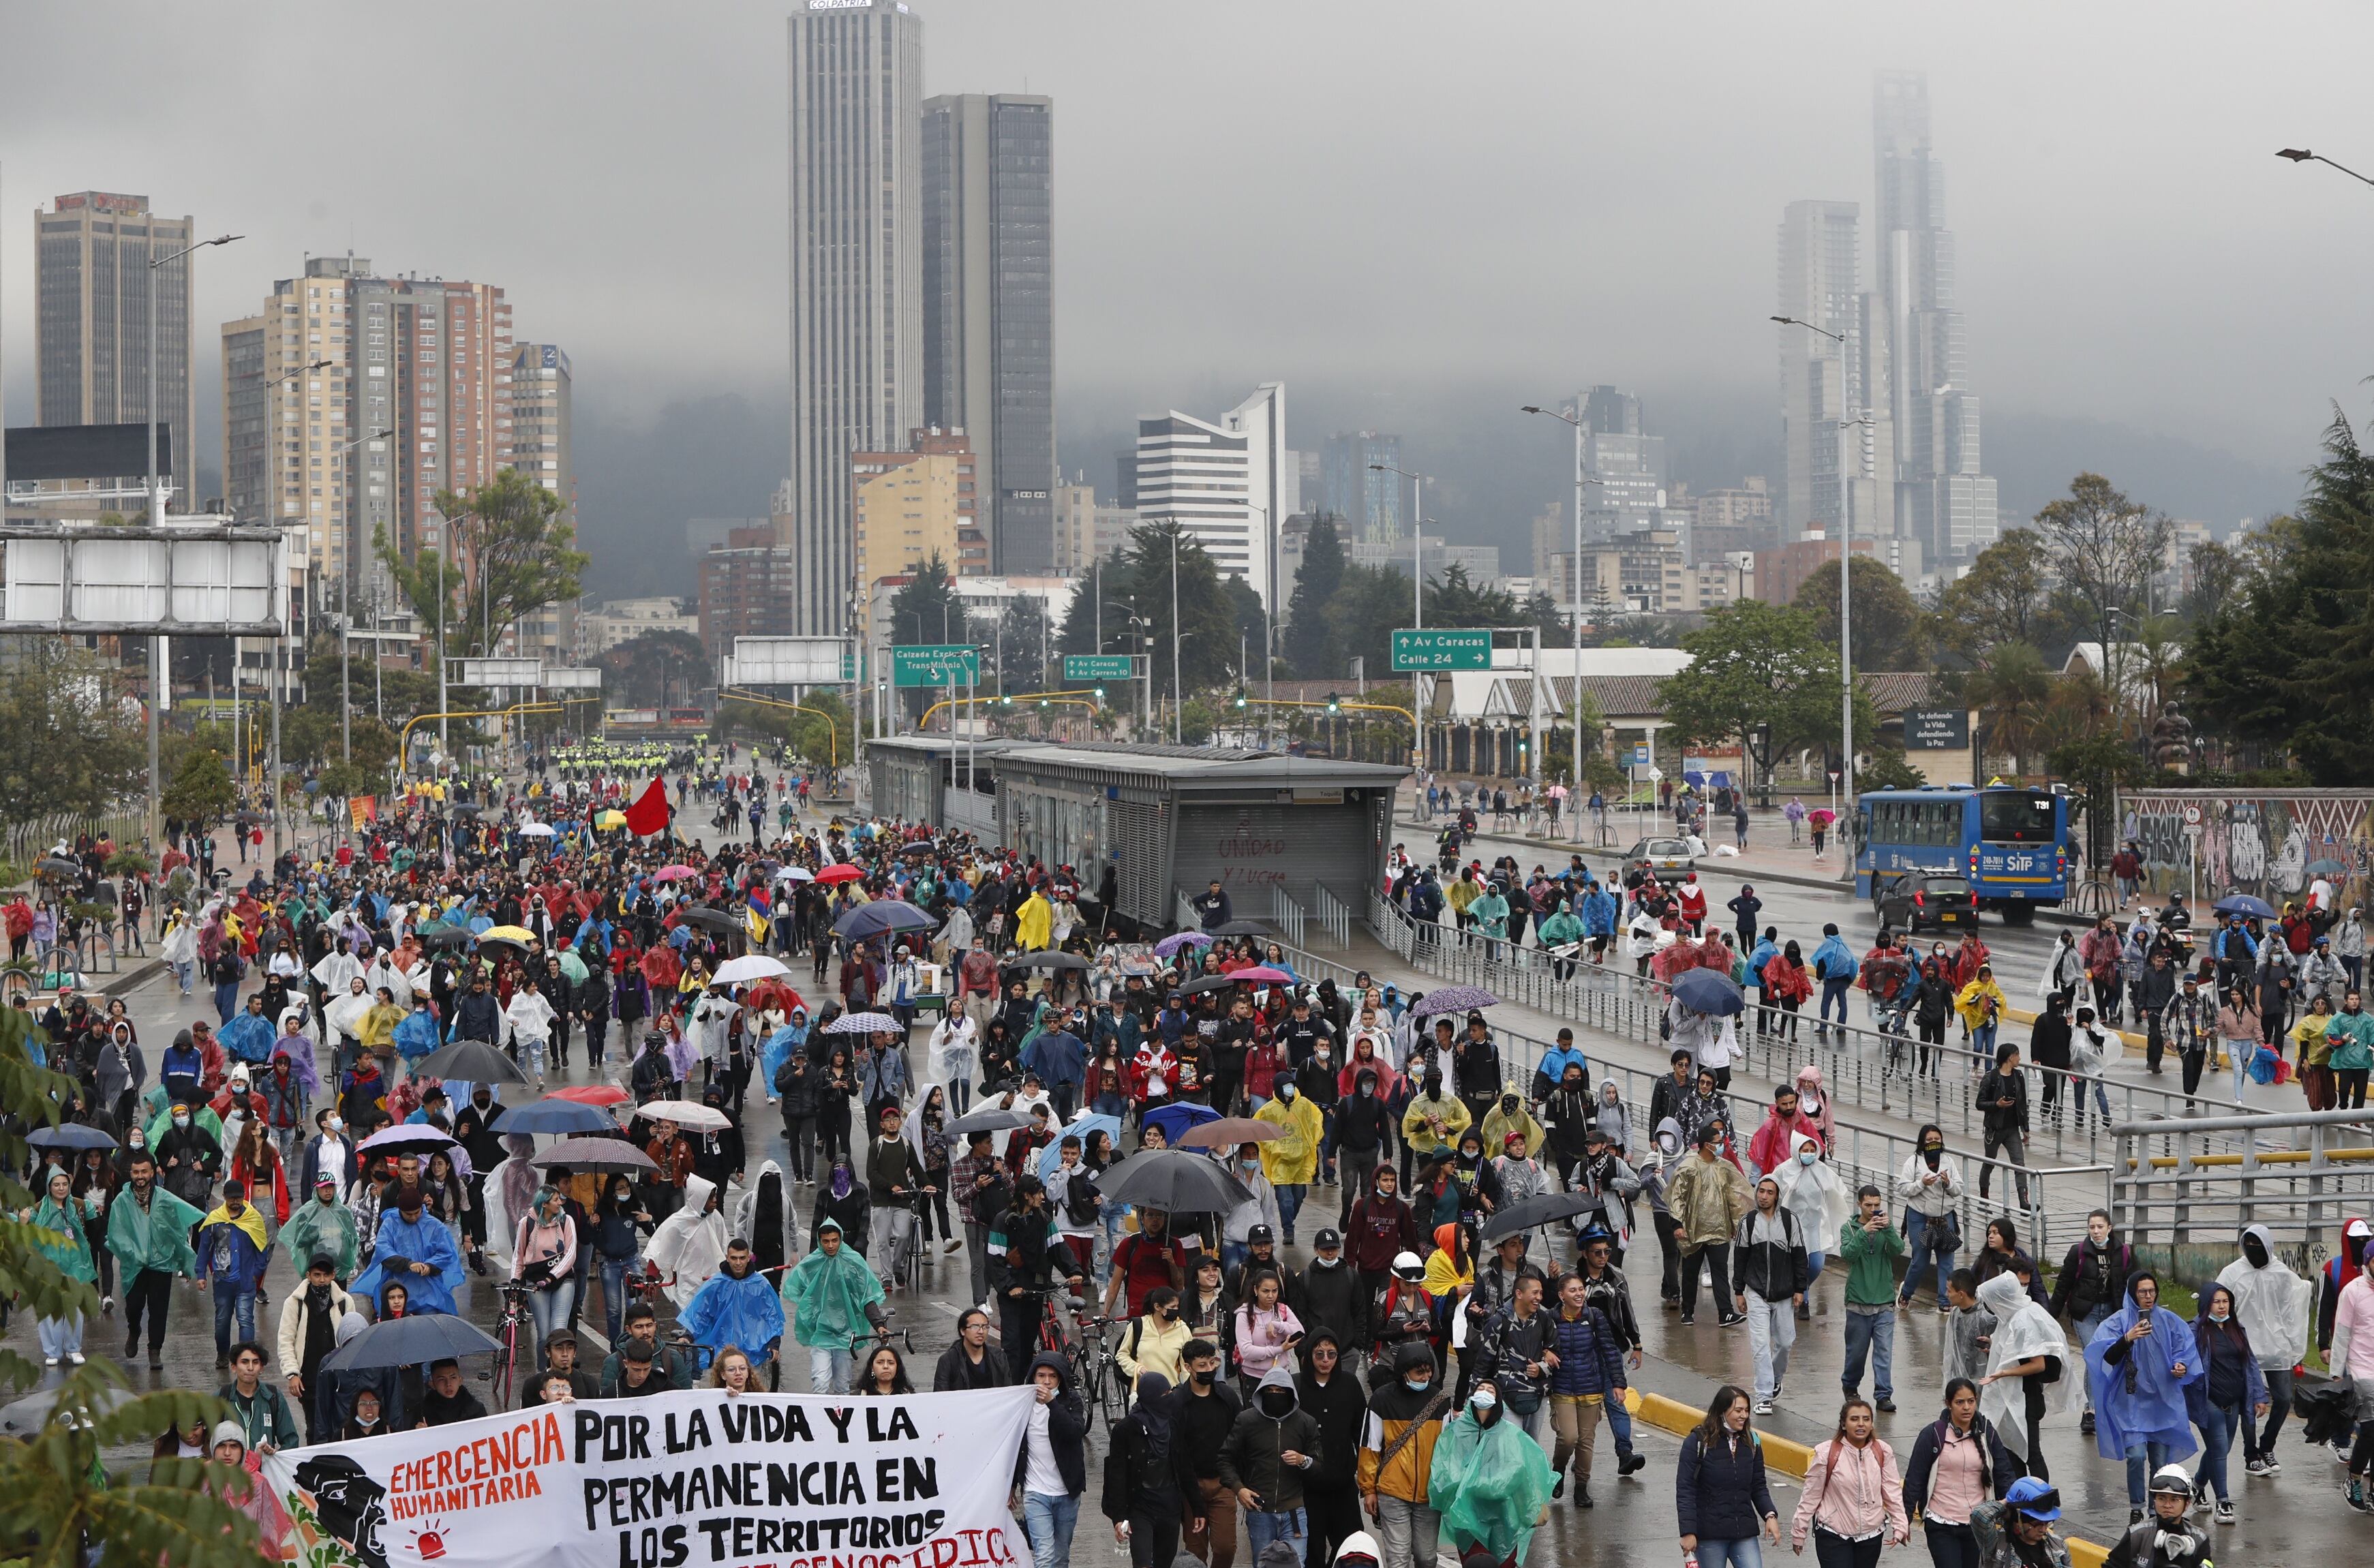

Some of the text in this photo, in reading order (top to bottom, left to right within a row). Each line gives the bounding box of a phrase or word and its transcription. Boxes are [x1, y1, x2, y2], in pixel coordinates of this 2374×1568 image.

[811, 0, 867, 8] COLPATRIA
[1414, 636, 1485, 646] Av Caracas
[1399, 654, 1452, 664] Calle 24
[1917, 730, 1955, 738] defendiendo
[2035, 801, 2050, 810] T31
[1219, 839, 1285, 857] UNIDAD
[1367, 1215, 1396, 1225] AMERICAN
[1371, 1225, 1390, 1233] EGLE
[1325, 1232, 1333, 1240] LA
[547, 1255, 562, 1267] adi
[575, 1403, 919, 1463] POR LA VIDA Y LA
[390, 1411, 566, 1494] EMERGENCIA
[389, 1470, 542, 1521] HUMANITARIA
[584, 1456, 939, 1531] PERMANENCIA EN
[619, 1509, 945, 1568] LOS TERRITORIOS
